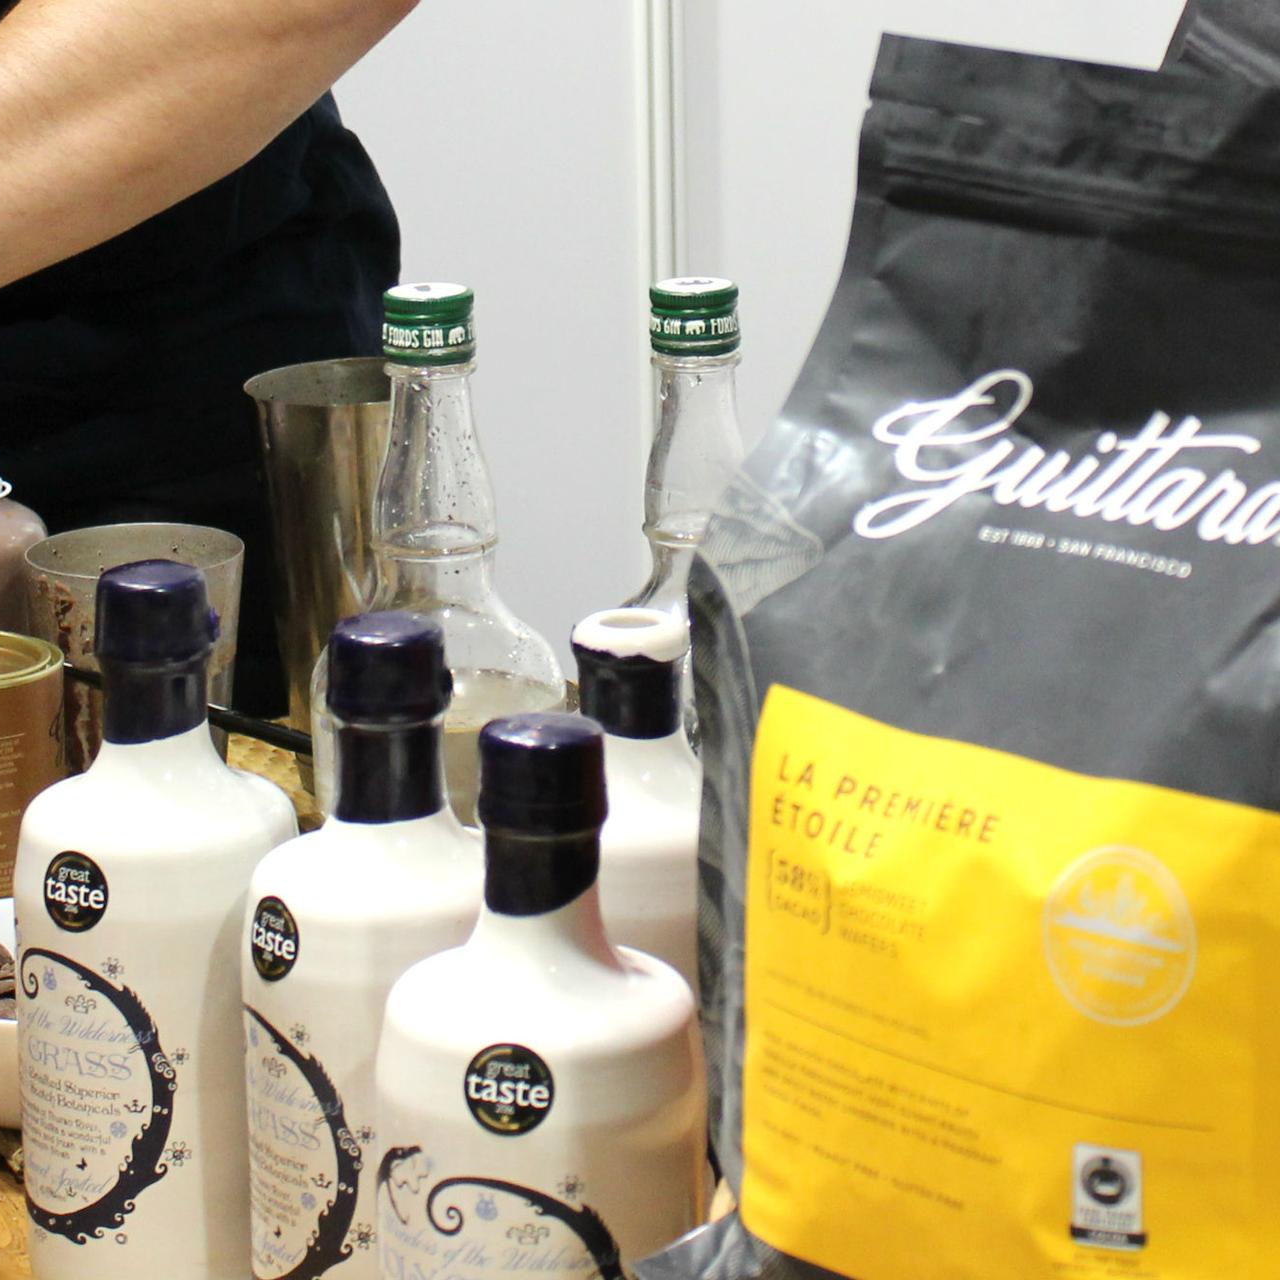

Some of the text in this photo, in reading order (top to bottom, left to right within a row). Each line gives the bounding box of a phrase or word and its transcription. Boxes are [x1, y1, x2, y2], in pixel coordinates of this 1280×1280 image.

[387, 326, 444, 348] FORDS GIN
[663, 318, 681, 335] GIN
[978, 525, 1010, 544] EST
[1056, 538, 1093, 556] SAN
[1093, 544, 1193, 579] FRANCISCO
[778, 754, 815, 790] LA
[58, 867, 90, 883] great
[47, 877, 105, 909] taste
[261, 912, 285, 931] great
[253, 922, 296, 960] taste
[29, 1035, 132, 1081] GRASS
[486, 1061, 531, 1079] great
[467, 1073, 550, 1108] taste
